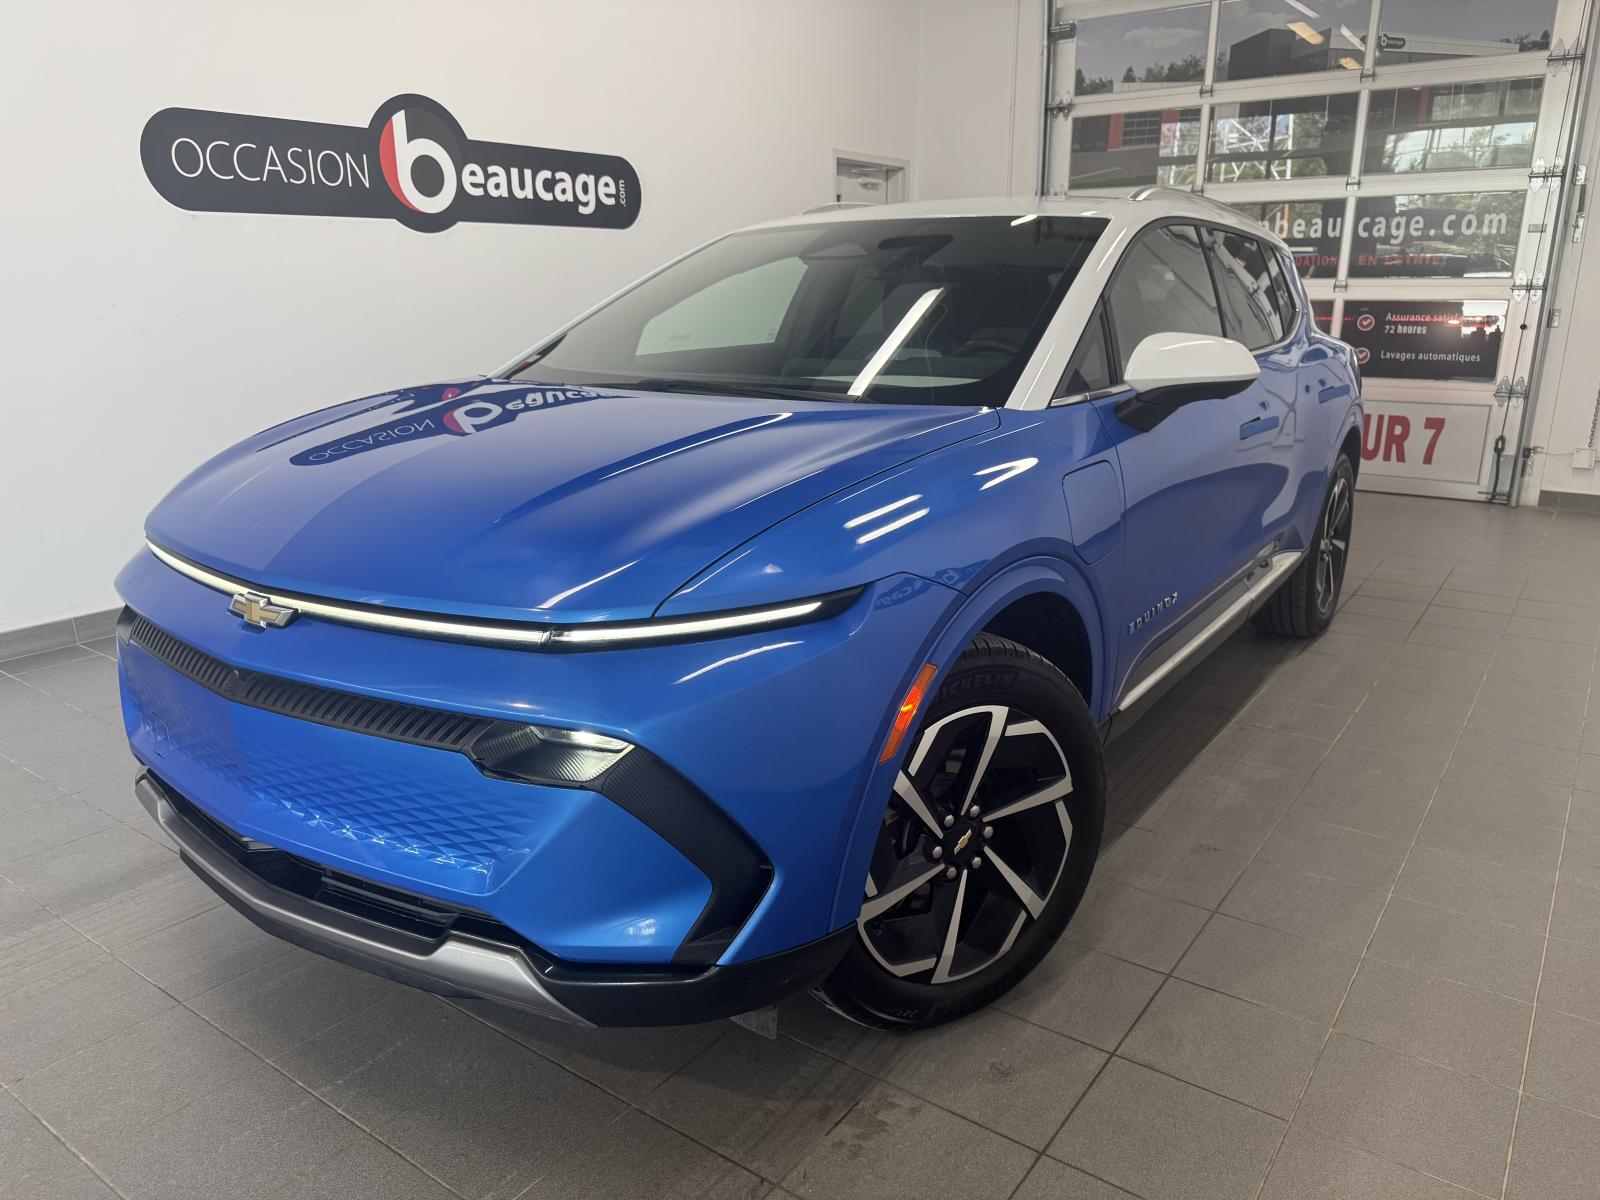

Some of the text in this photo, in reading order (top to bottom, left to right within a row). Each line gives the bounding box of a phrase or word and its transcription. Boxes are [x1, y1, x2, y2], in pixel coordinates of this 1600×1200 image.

[170, 137, 370, 189] OCCASION
[1358, 255, 1377, 266] EN
[1385, 312, 1431, 322] Assurance
[1384, 324, 1427, 335] 72 heures
[1380, 350, 1481, 364] Lavages automatiques
[1361, 413, 1446, 465] UR 7
[1127, 591, 1178, 635] EQUINOX
[936, 671, 1017, 703] ICHELIN
